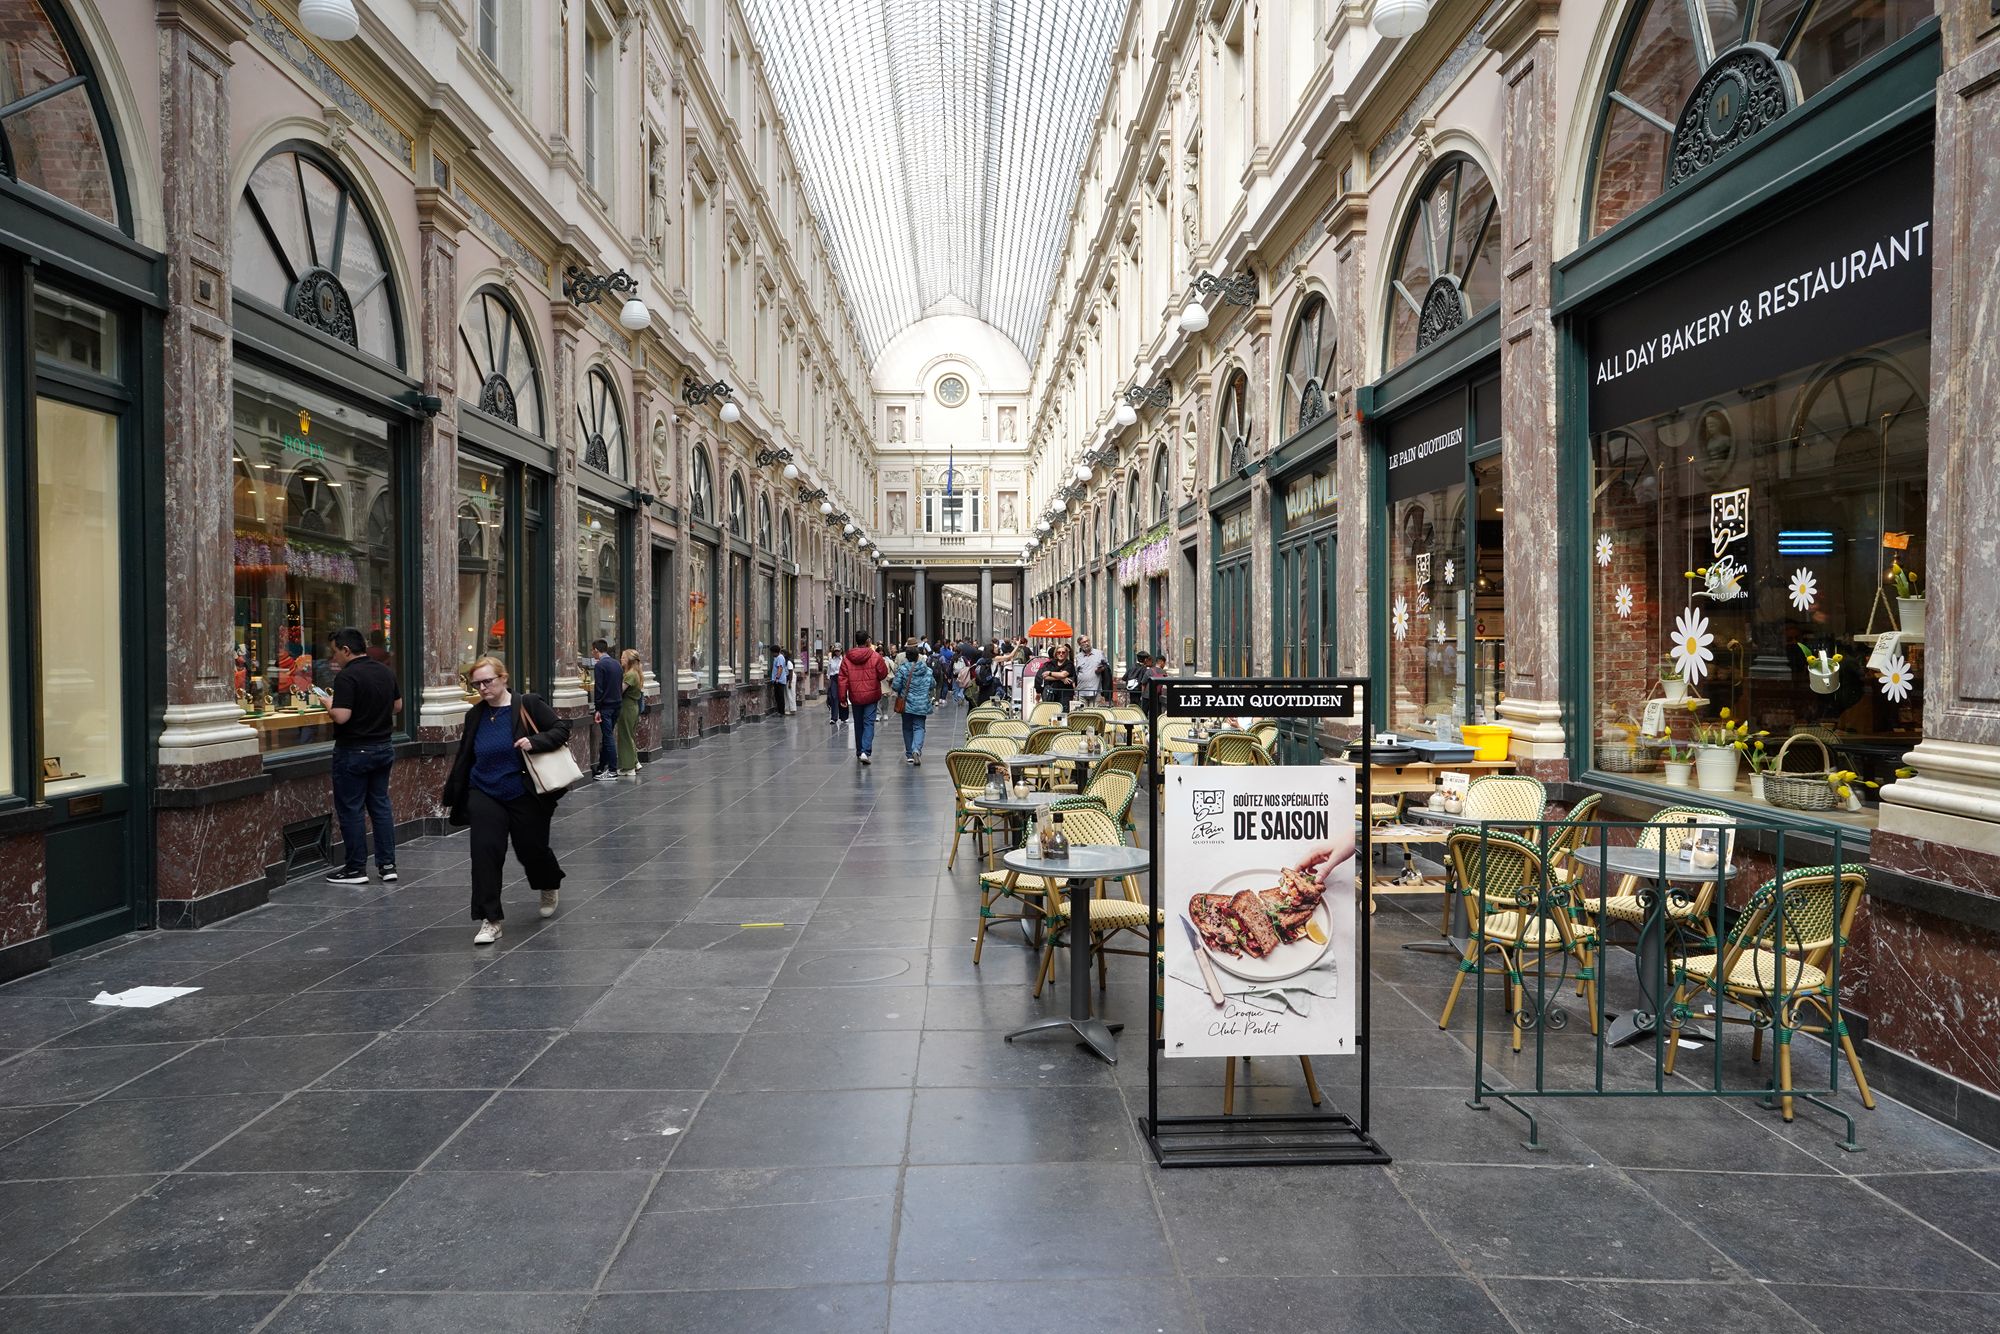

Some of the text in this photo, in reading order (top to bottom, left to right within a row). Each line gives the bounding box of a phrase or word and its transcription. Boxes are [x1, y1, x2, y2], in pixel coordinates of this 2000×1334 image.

[1596, 221, 1929, 385] ALL DAY BAKERY & RESTAURANT
[284, 435, 326, 462] ROLEX
[1389, 427, 1463, 470] LE PAIN QUOTIDIEN
[1179, 694, 1343, 708] LE PAIN QUOTIDIEN
[1233, 792, 1329, 807] GOÛTEZ NOS SPÉCIALITÉS
[1193, 821, 1225, 838] Pain
[1233, 811, 1329, 840] DE SAISON
[1223, 1004, 1265, 1022] Croque
[1207, 1021, 1283, 1036] Club Poulet
